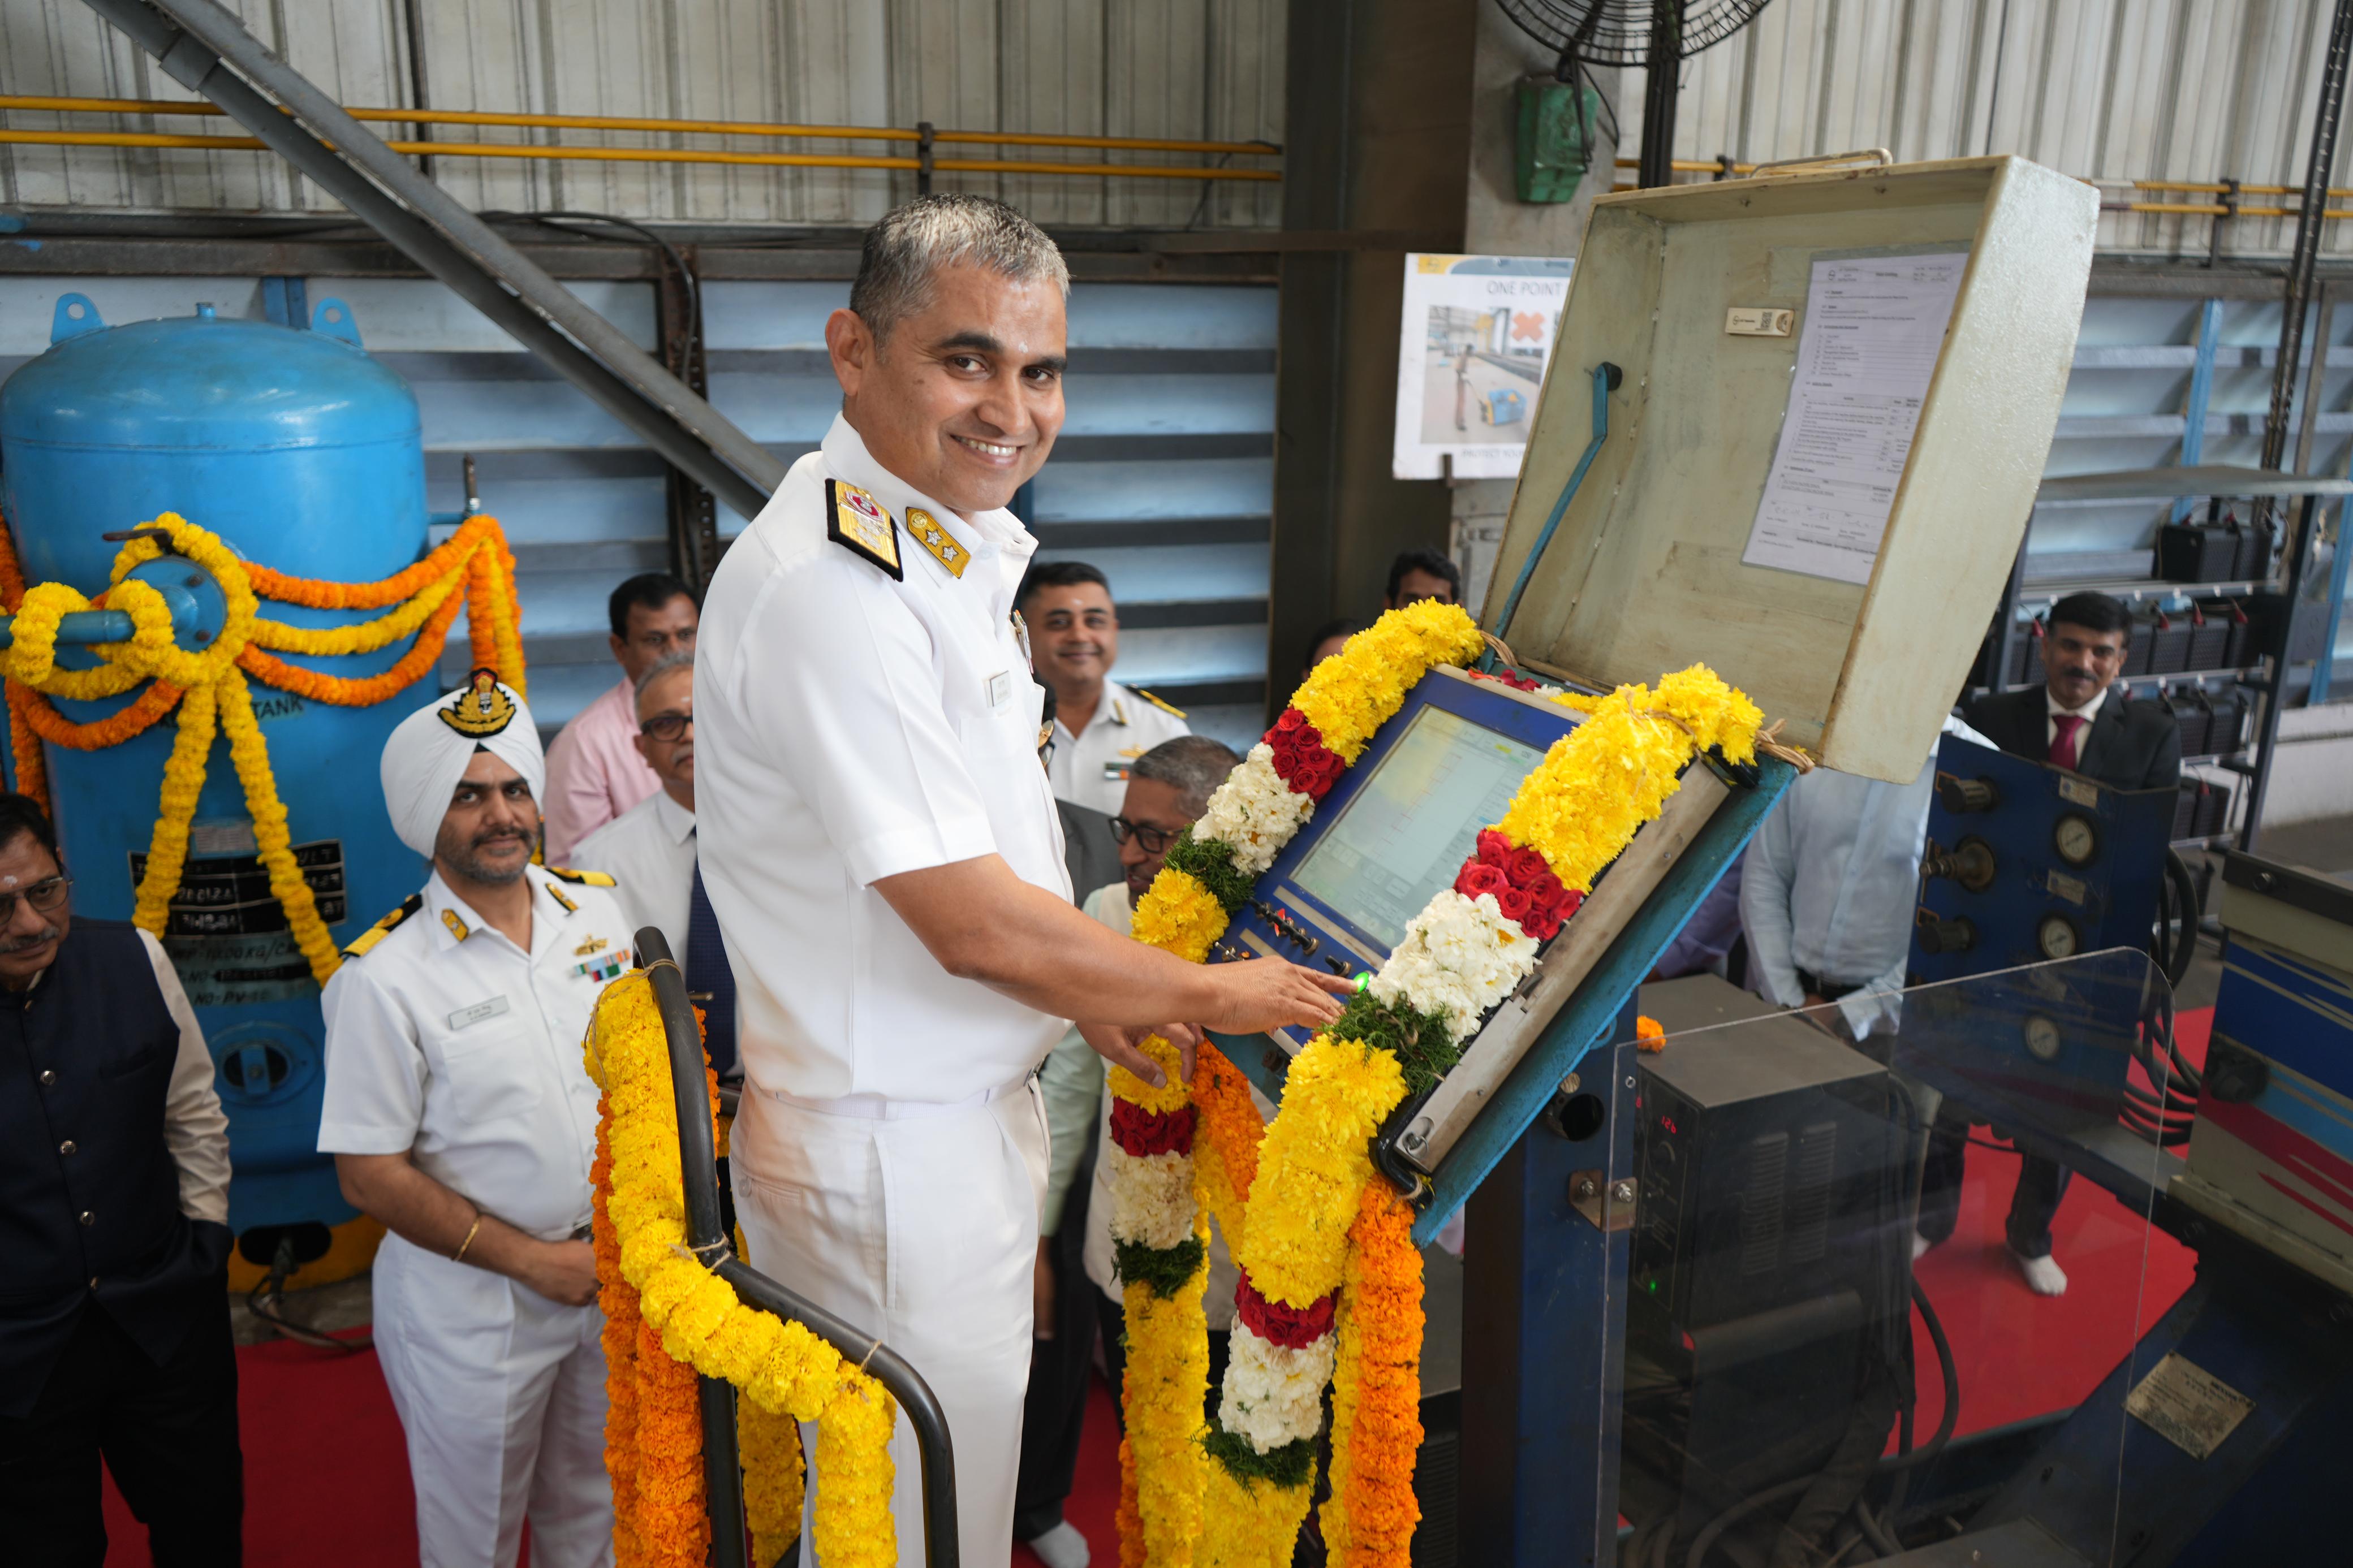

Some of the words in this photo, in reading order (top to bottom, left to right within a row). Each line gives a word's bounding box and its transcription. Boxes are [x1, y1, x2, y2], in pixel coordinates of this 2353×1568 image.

[1486, 280, 1516, 295] ONE
[1520, 281, 1563, 296] POINT
[251, 696, 303, 719] TANK
